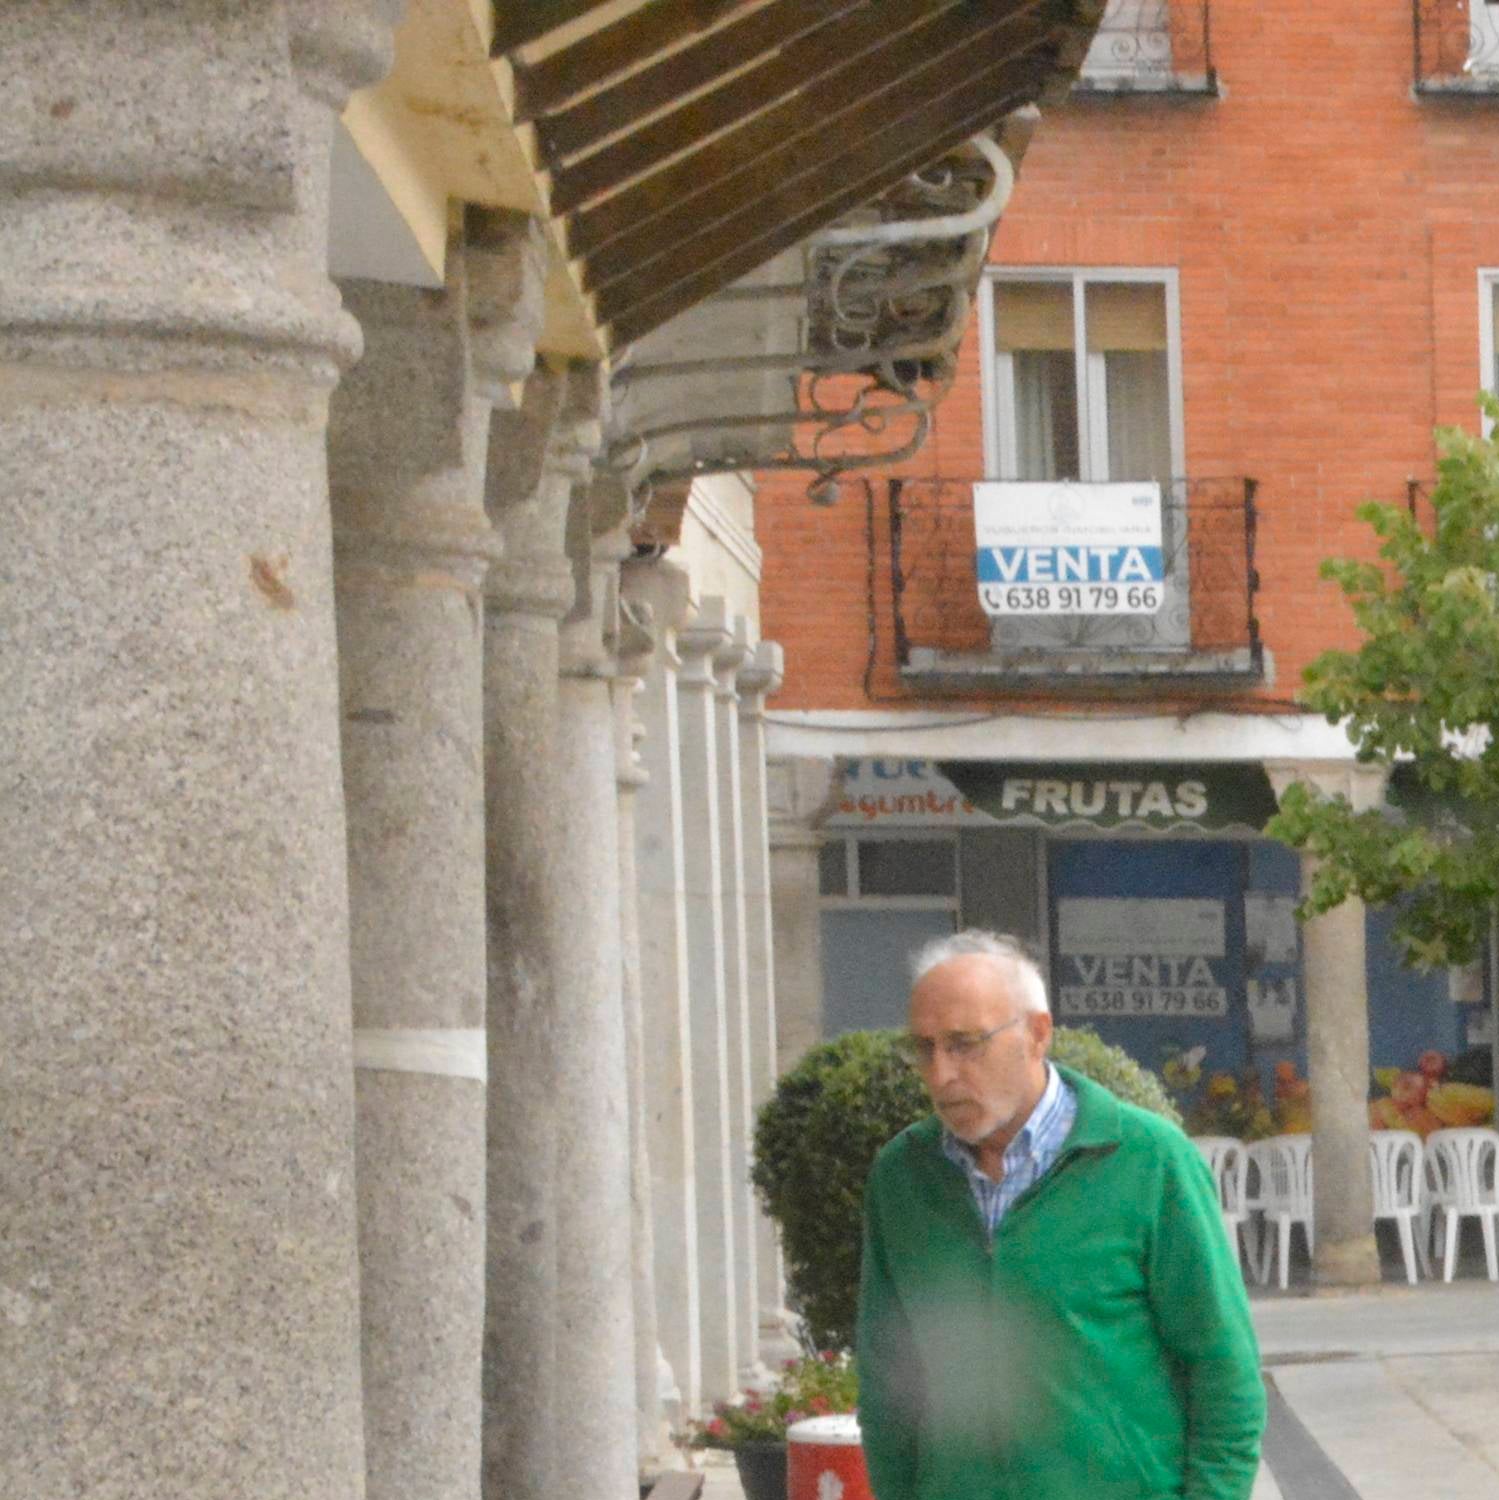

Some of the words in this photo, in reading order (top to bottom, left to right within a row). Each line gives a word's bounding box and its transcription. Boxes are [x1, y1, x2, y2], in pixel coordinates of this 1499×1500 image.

[991, 548, 1152, 581] VENTA
[1006, 586, 1050, 609] 638
[1058, 586, 1081, 609] 91
[1089, 586, 1118, 609] 79
[1127, 586, 1157, 609] 66
[1002, 778, 1208, 818] FRUTAS
[1074, 956, 1217, 986] VENTA
[1084, 991, 1124, 1011] 638
[1132, 991, 1151, 1011] 91
[1162, 991, 1186, 1011] 79
[1193, 991, 1220, 1011] 66
